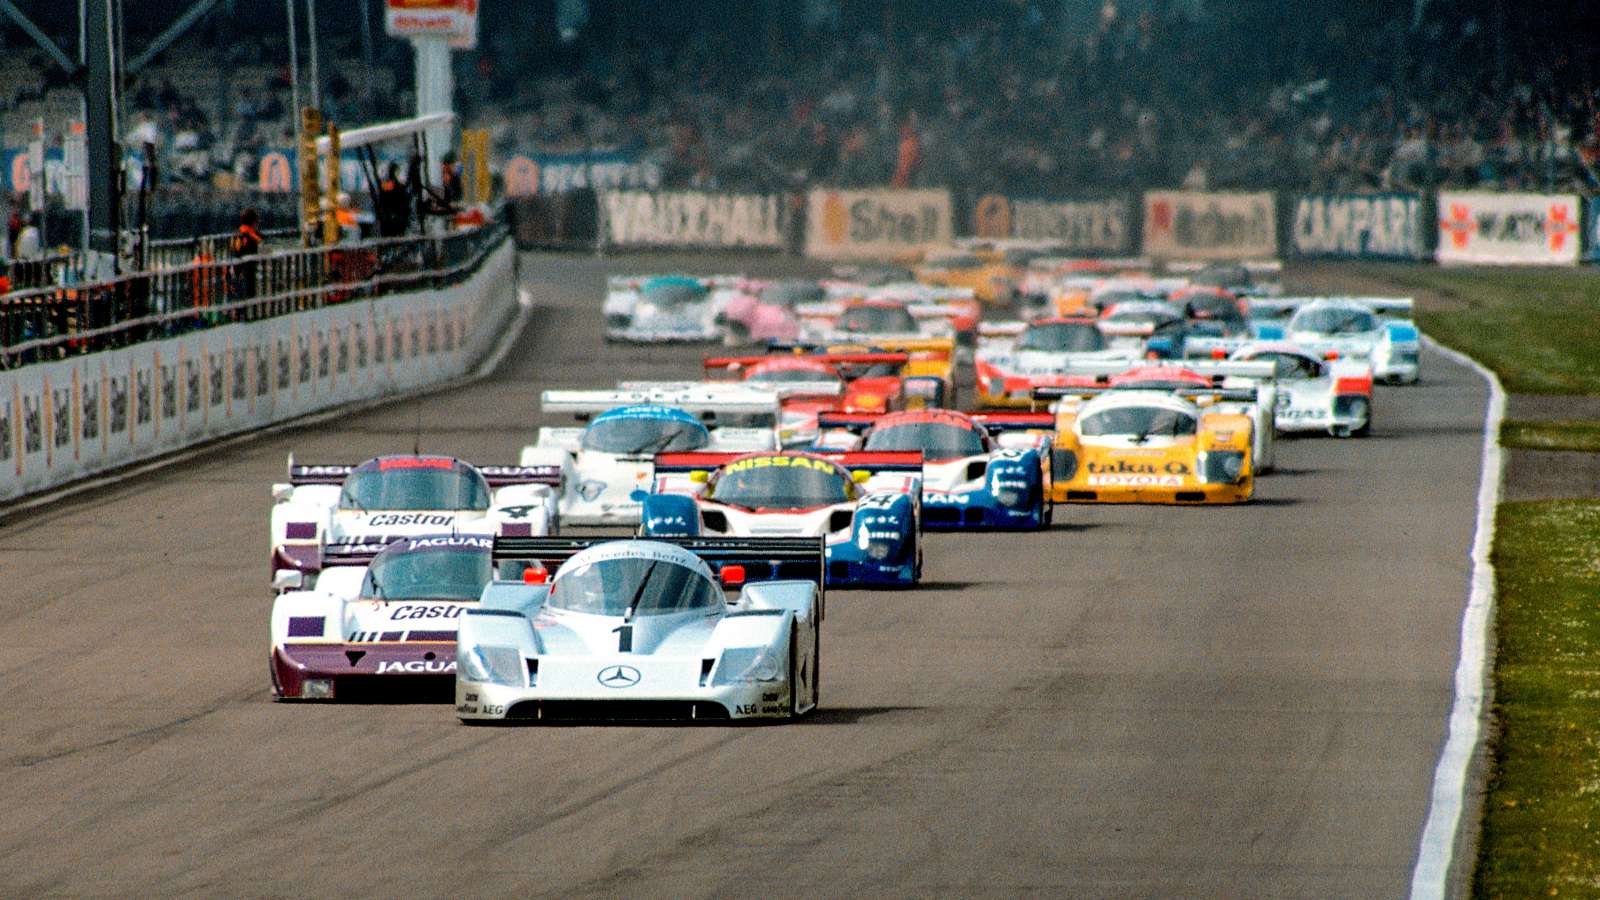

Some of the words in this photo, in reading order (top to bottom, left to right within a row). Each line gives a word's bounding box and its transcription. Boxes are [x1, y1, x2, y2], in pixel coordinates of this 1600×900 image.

[603, 190, 783, 245] VAUXHALL
[849, 197, 941, 243] Shell
[1295, 197, 1422, 253] CAMPARI
[725, 456, 834, 476] NISSAN
[498, 504, 539, 519] 4
[580, 549, 687, 566] Mrcedes-Benz
[390, 604, 466, 621] Castr
[611, 625, 633, 653] 1
[375, 660, 458, 675] JAGUA
[481, 704, 504, 715] AEG
